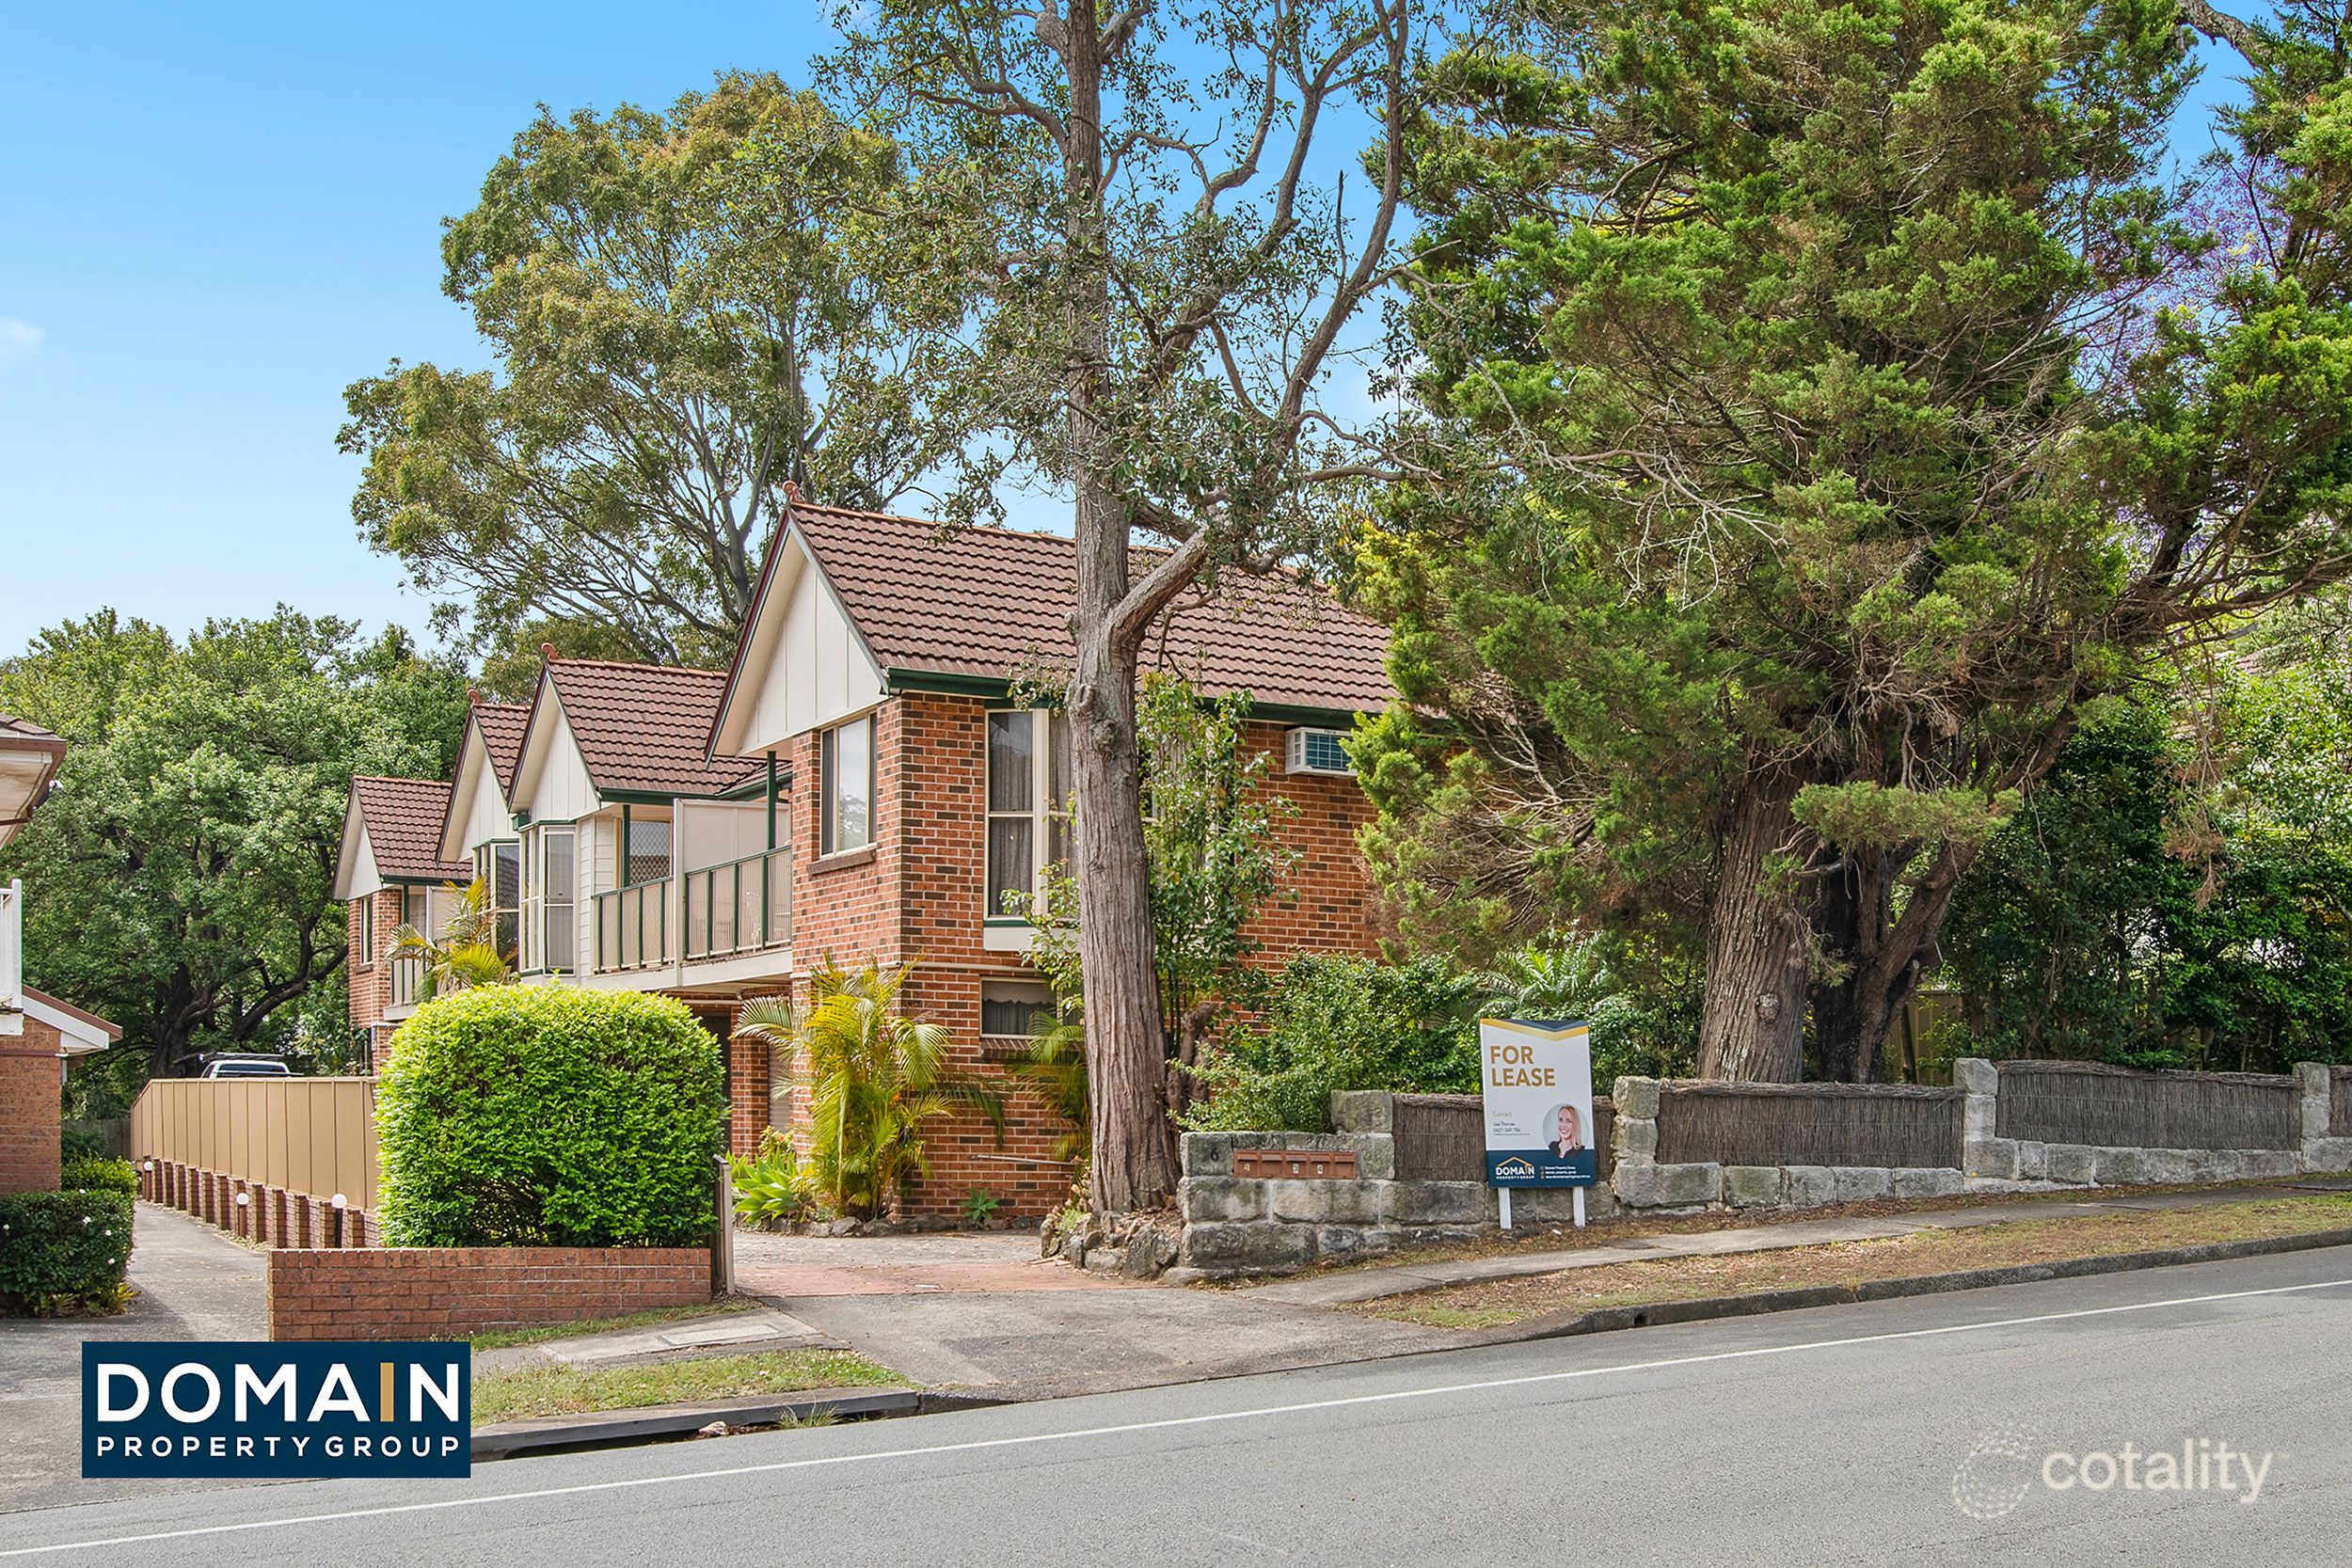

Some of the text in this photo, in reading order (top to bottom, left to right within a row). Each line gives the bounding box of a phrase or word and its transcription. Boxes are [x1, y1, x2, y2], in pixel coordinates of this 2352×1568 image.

[1489, 1045, 1534, 1065] FOR
[1490, 1068, 1556, 1087] LEASE
[1210, 1148, 1220, 1162] 6
[1495, 1166, 1534, 1175] DOMAIN
